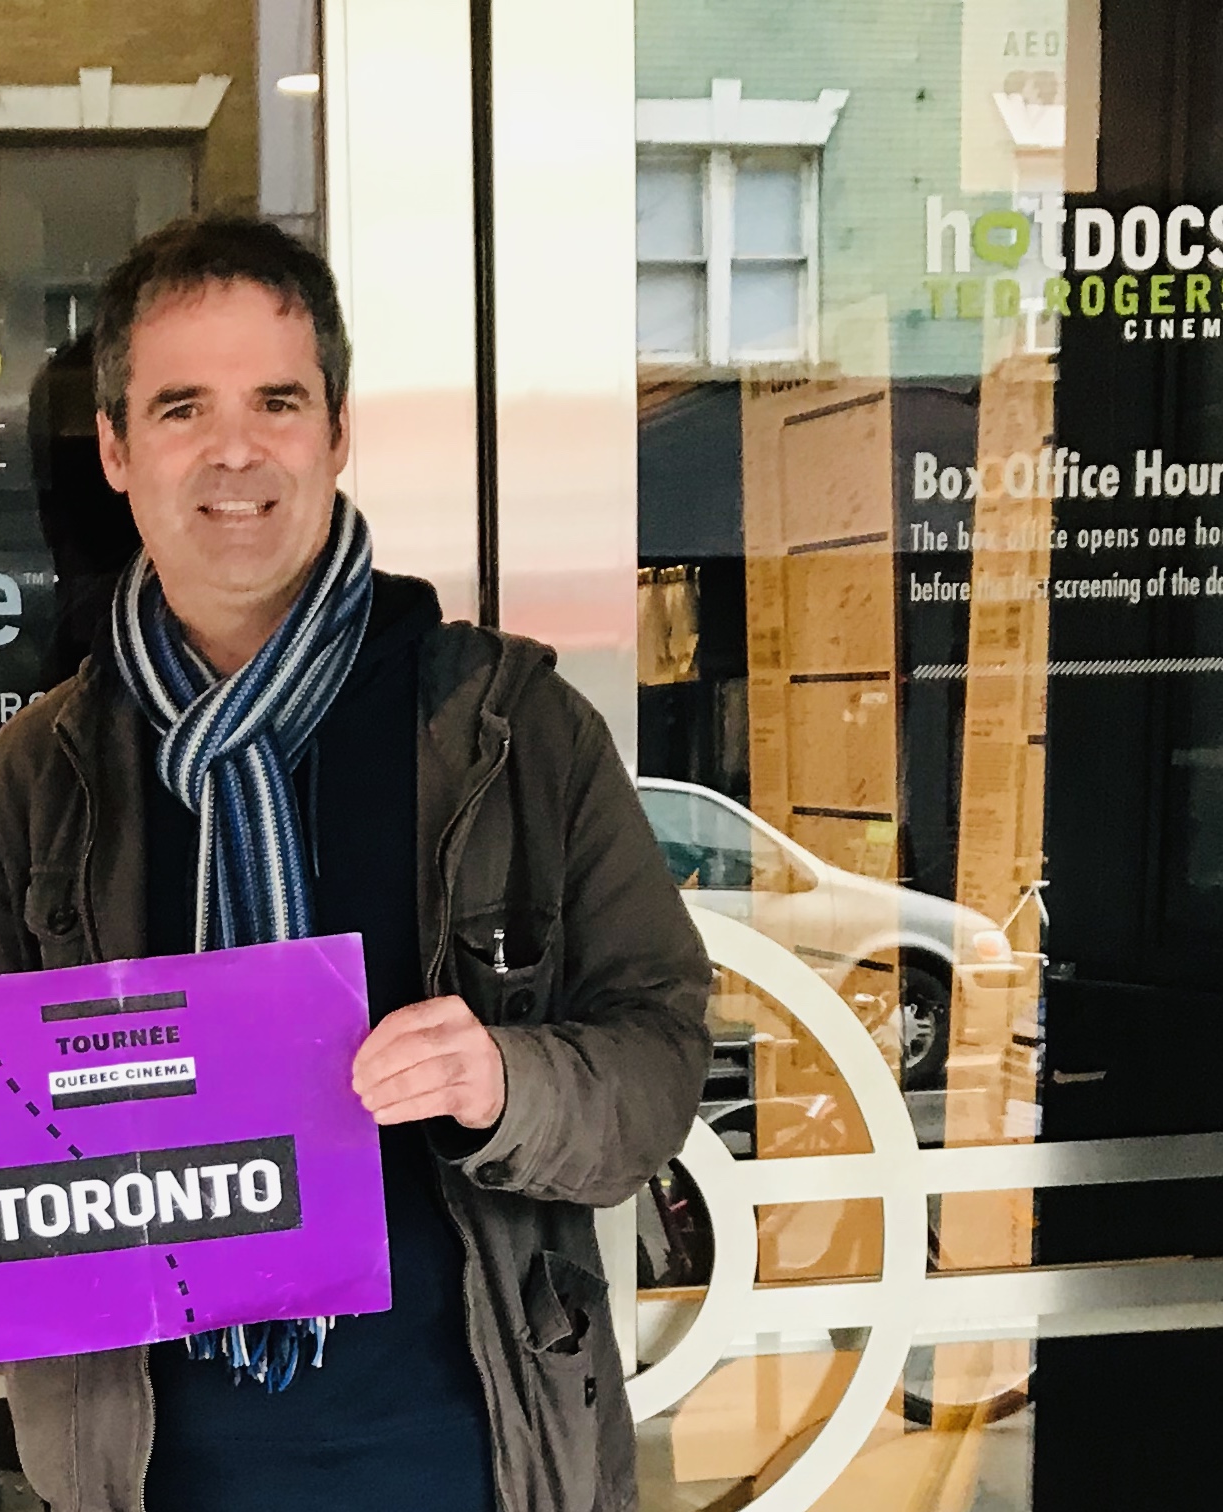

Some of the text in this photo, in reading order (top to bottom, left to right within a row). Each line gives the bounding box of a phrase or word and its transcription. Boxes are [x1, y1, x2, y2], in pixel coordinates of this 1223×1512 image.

[1043, 274, 1223, 317] ROGER
[913, 451, 981, 500] Box
[1004, 447, 1120, 498] Office
[910, 521, 948, 551] The
[1077, 523, 1139, 554] opens
[1148, 525, 1186, 547] one
[1195, 515, 1223, 545] ho
[910, 571, 972, 602] before
[1054, 571, 1141, 604] screening
[1146, 567, 1166, 597] of
[1171, 566, 1200, 596] the
[56, 1025, 181, 1055] TOURNÉE
[54, 1061, 190, 1089] QUÉBEC CINÉMA
